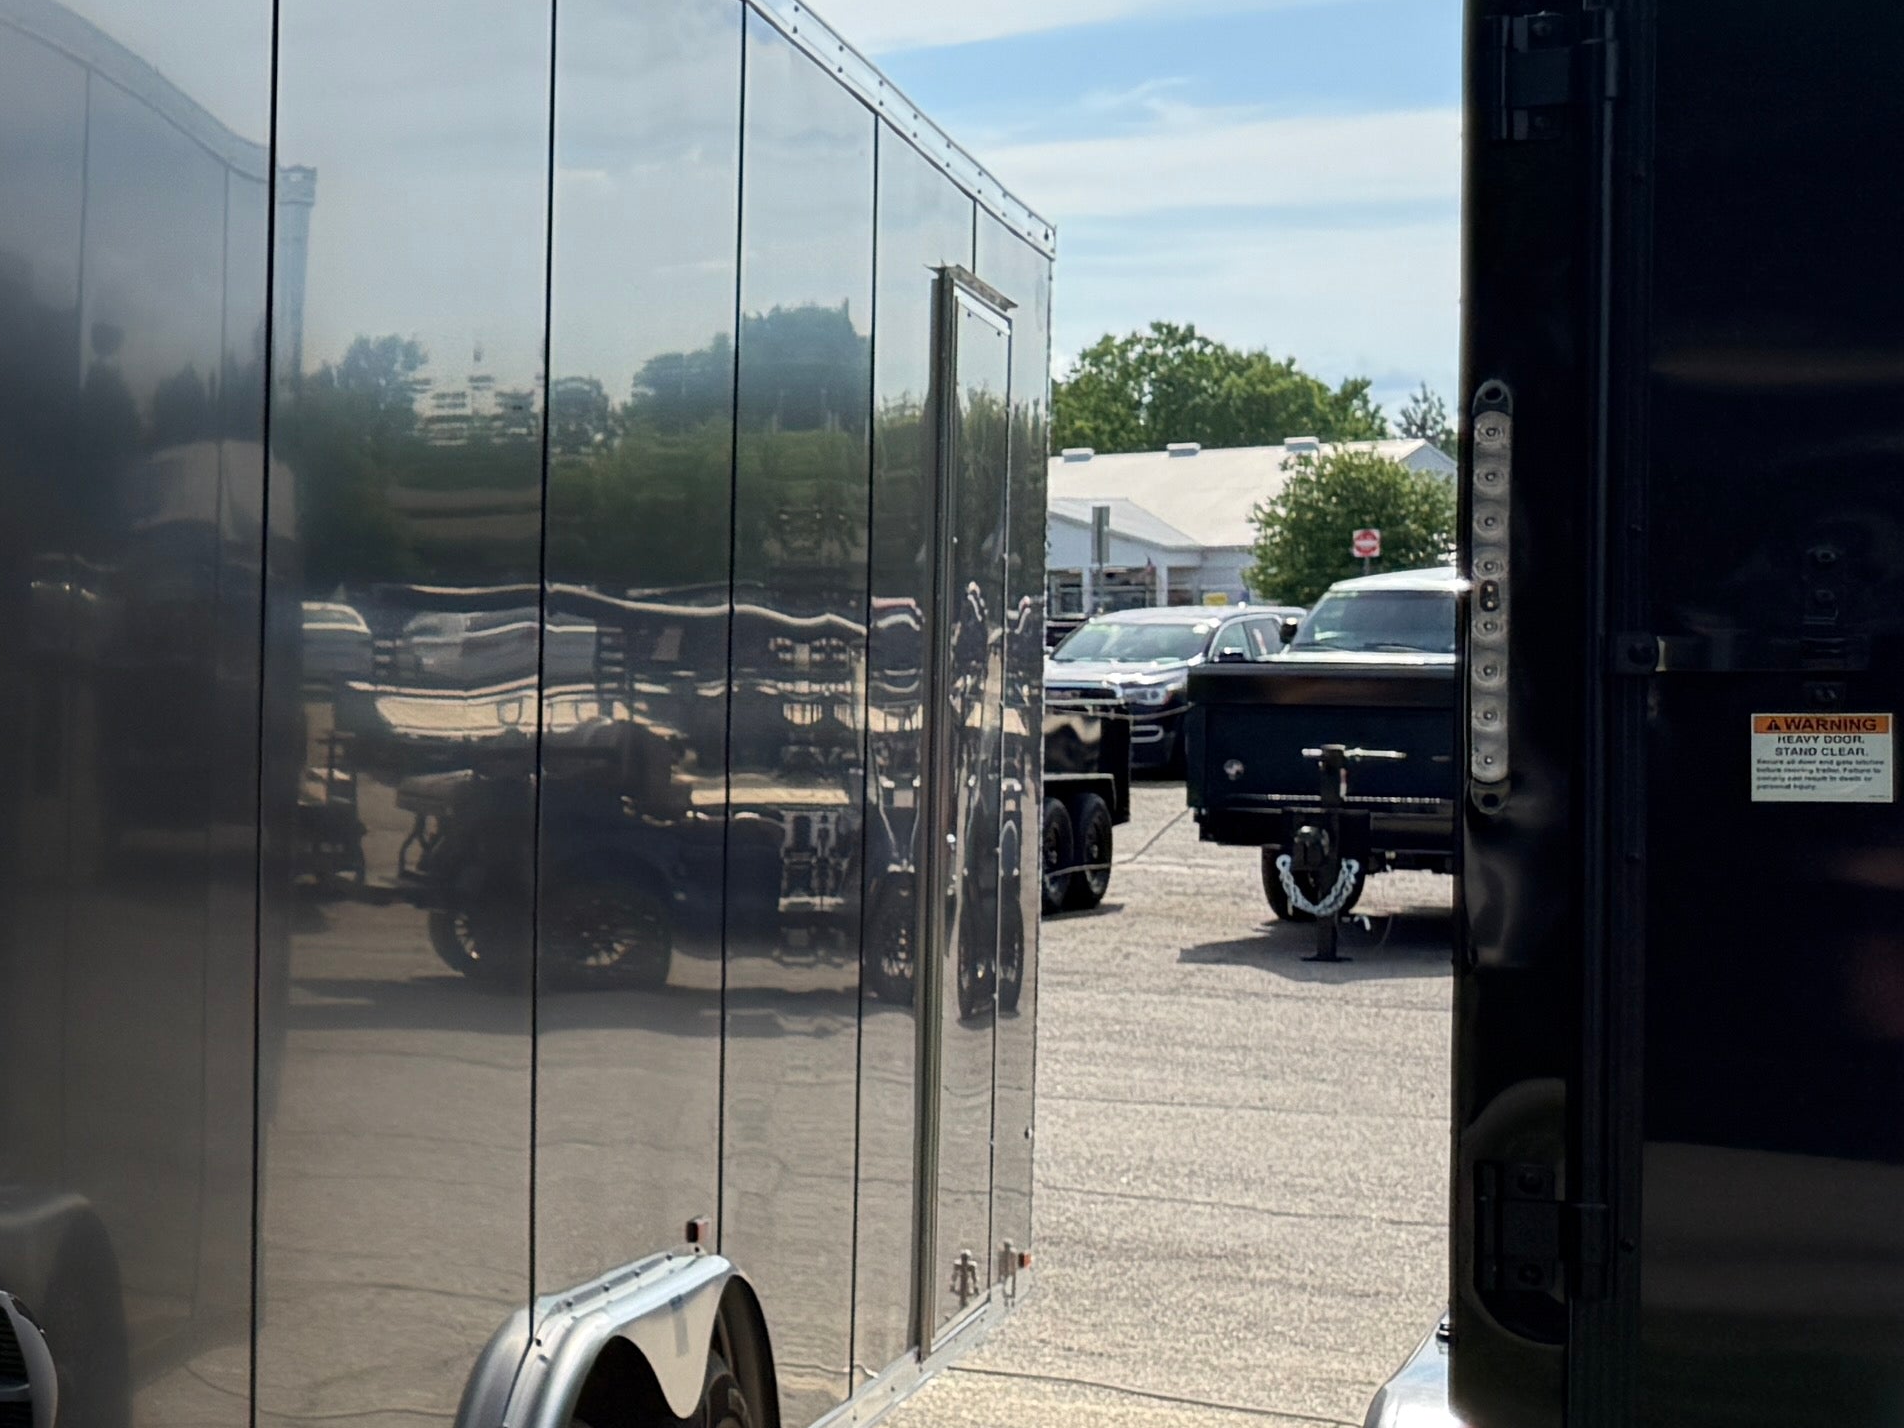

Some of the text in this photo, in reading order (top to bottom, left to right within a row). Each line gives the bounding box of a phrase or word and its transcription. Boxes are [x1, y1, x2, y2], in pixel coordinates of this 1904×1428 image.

[1783, 717, 1877, 731] WARNING
[1777, 735, 1820, 744] HEAVY
[1775, 747, 1818, 756] STAND
